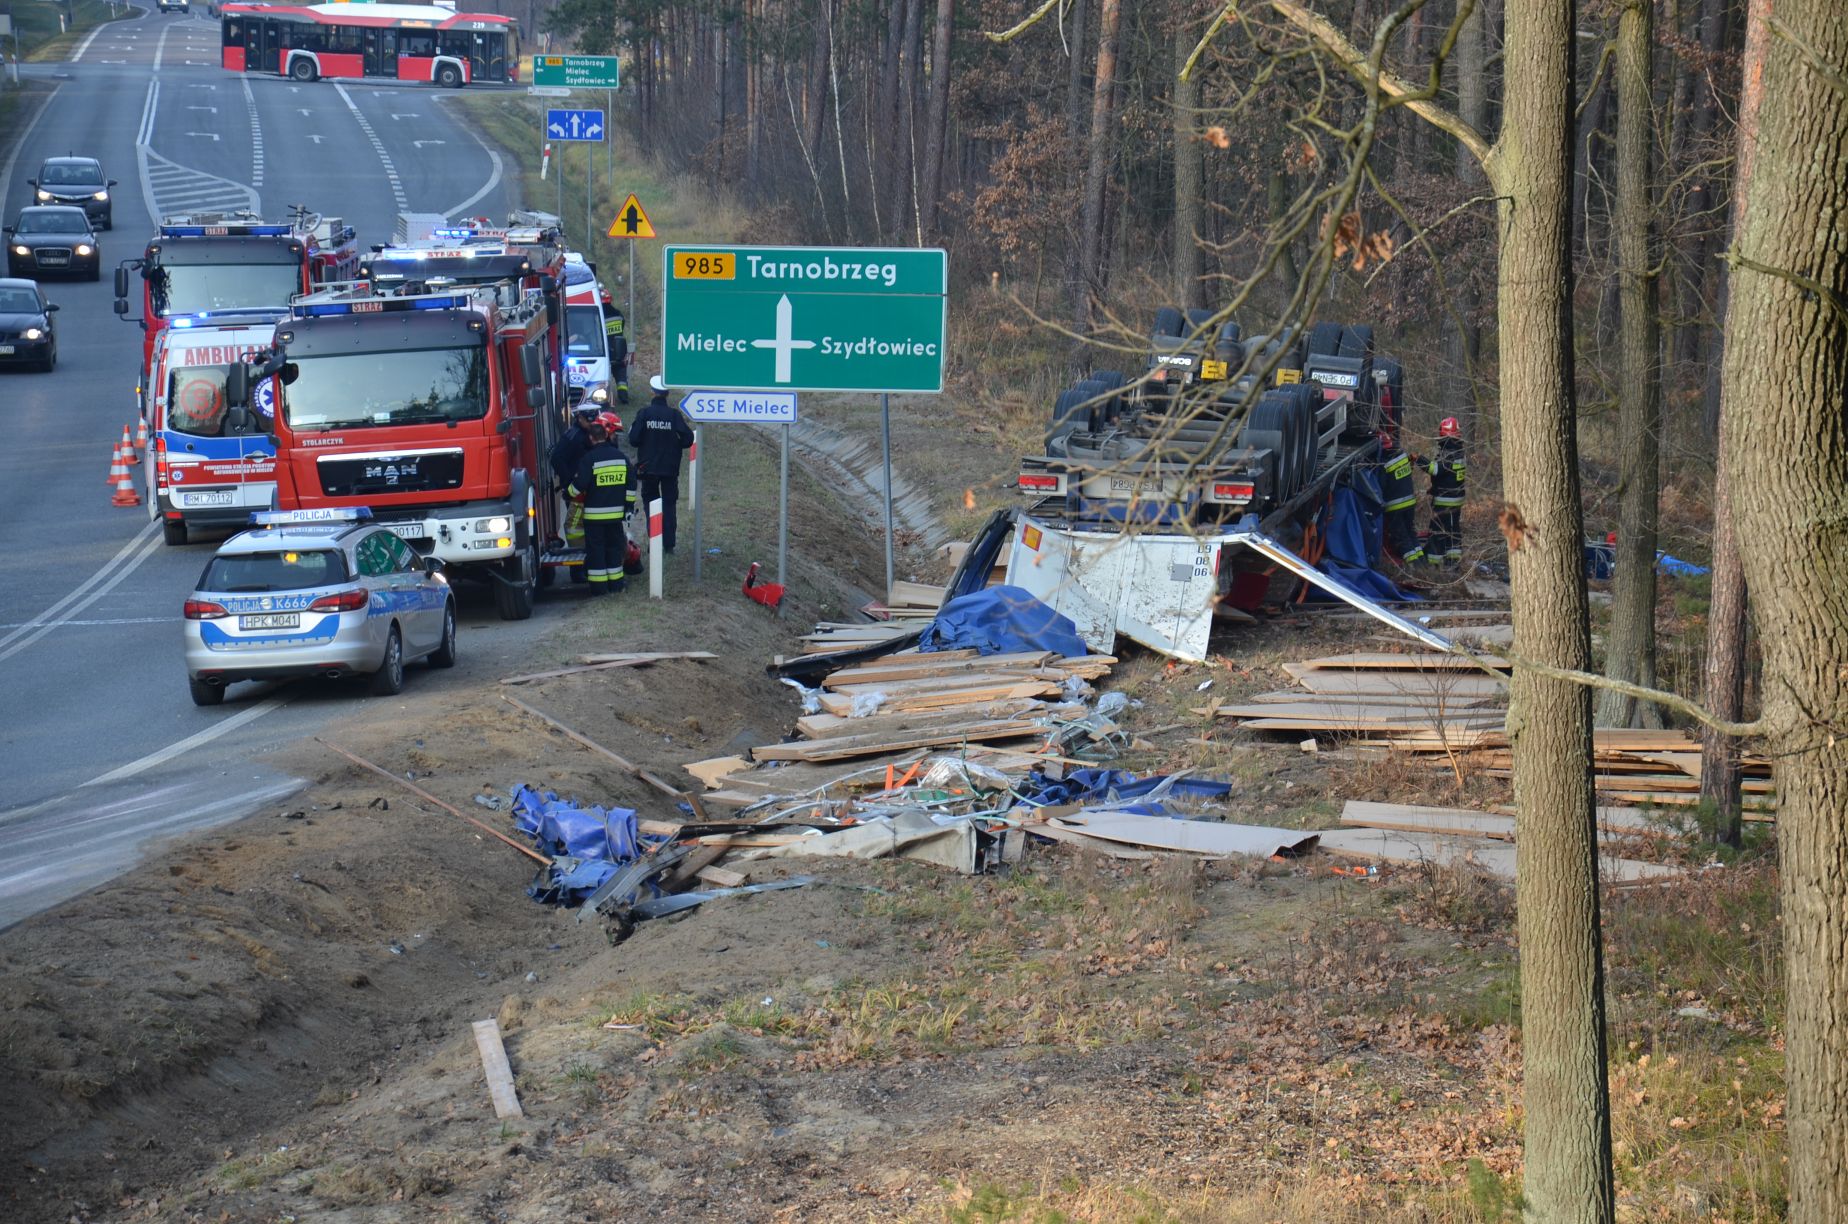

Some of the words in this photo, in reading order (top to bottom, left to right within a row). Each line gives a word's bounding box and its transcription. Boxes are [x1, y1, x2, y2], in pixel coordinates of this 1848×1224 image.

[565, 58, 605, 68] Tarnobrzeg
[565, 67, 590, 75] Mielec
[685, 257, 724, 275] 985
[747, 255, 897, 287] Tarnobrzeg
[677, 333, 747, 353] Mielec
[820, 336, 937, 359] Szydłowiec
[695, 399, 725, 414] SSE
[733, 399, 789, 415] Mielec
[646, 420, 672, 430] POLICJA
[302, 437, 344, 447] STOLARCZYK
[366, 464, 417, 478] MAN
[188, 494, 203, 505] RMI
[206, 493, 231, 504] 70112
[292, 510, 333, 521] POLICJA
[227, 601, 261, 612] POLICJA
[276, 597, 308, 609] K666
[245, 615, 268, 627] HPK
[271, 613, 298, 627] M041
